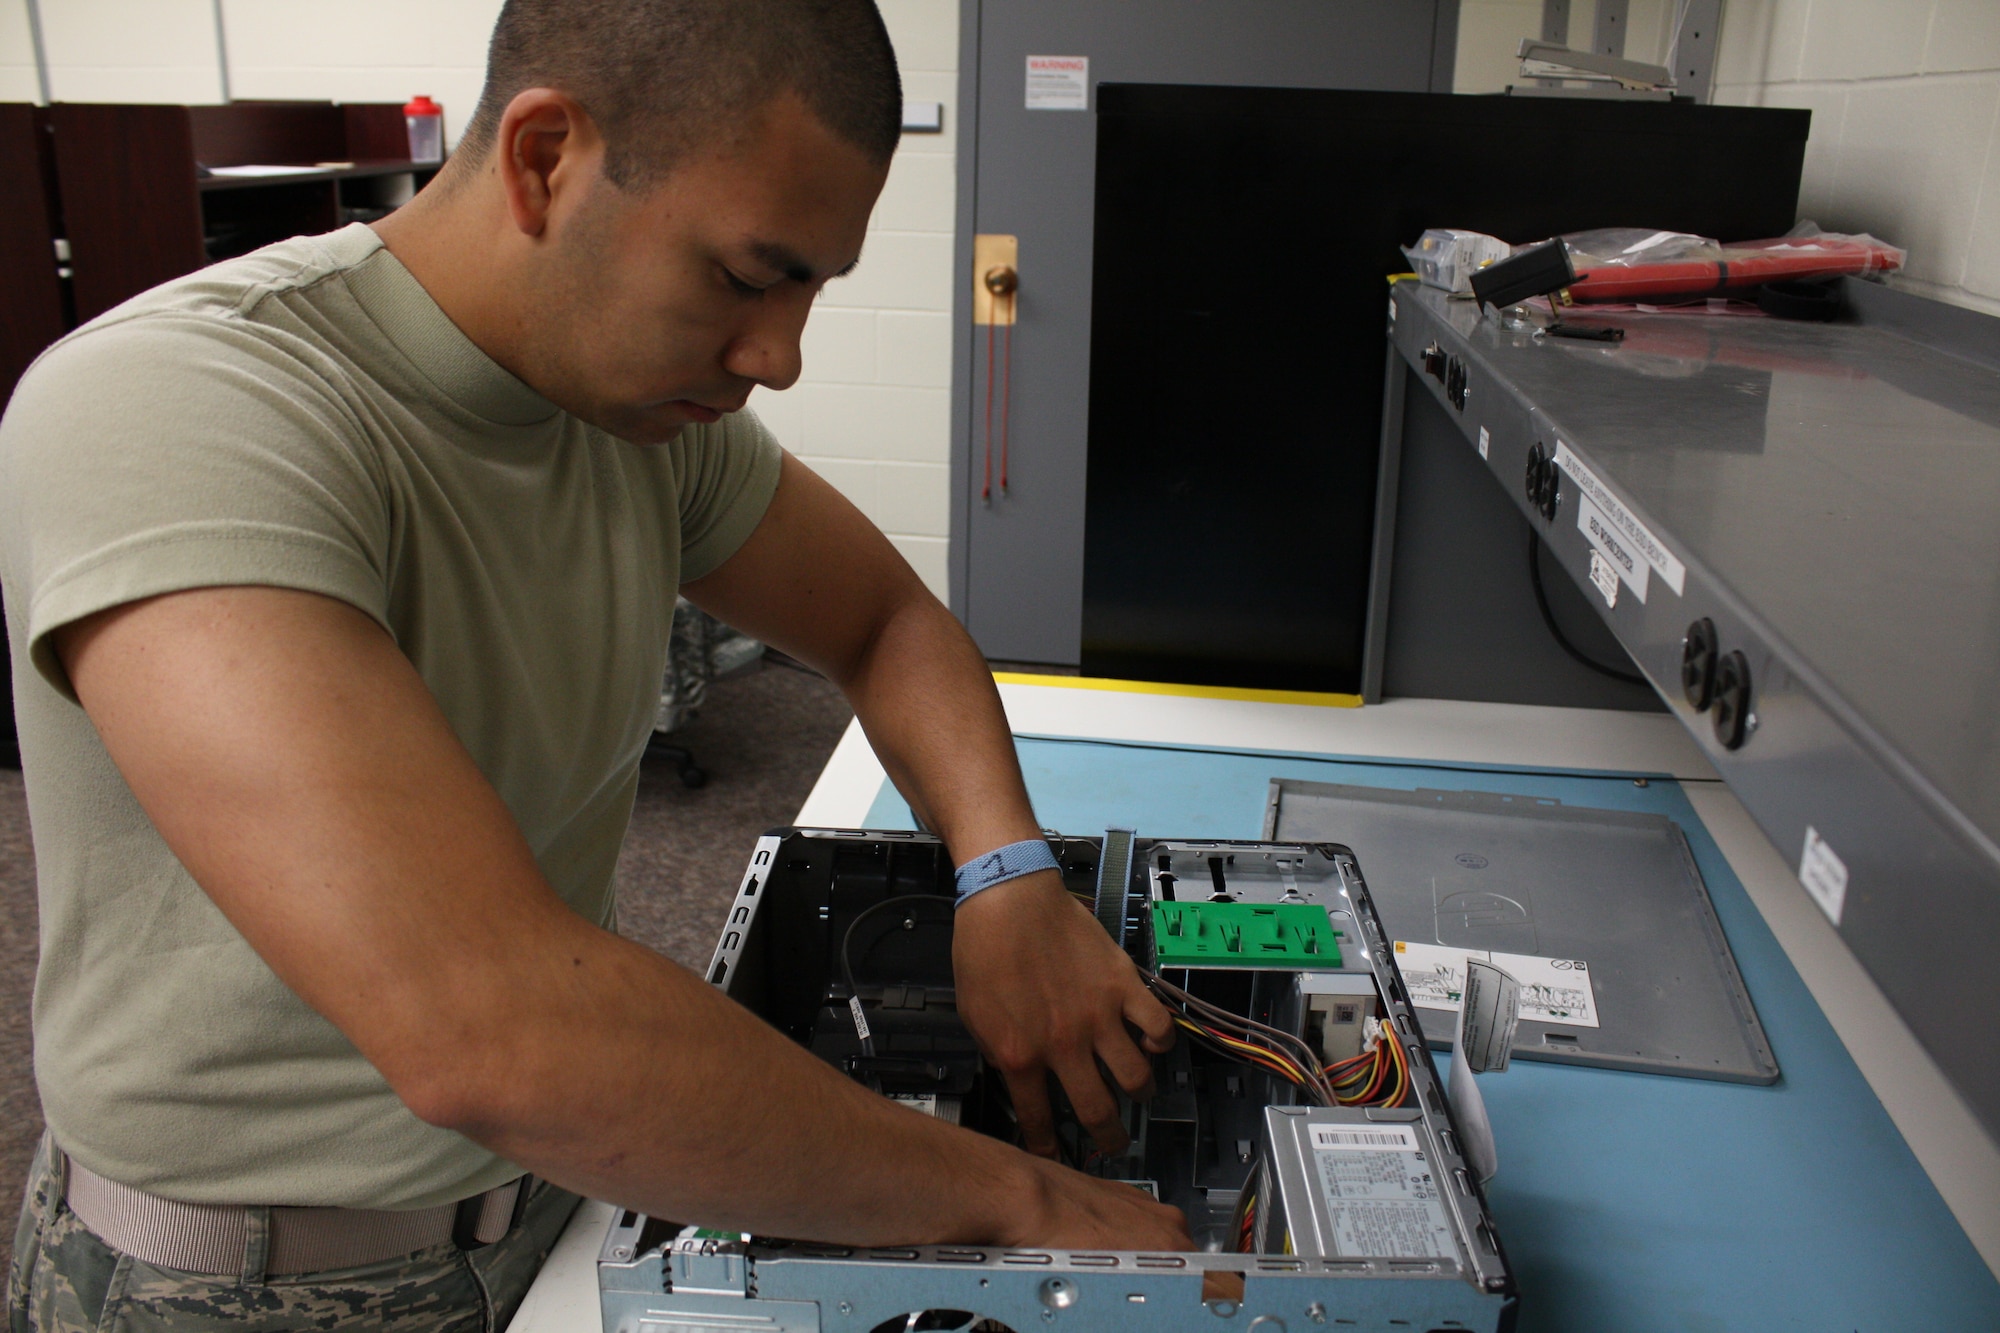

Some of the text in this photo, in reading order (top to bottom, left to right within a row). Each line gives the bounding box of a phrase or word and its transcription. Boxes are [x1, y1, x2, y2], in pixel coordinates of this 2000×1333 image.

[1030, 60, 1085, 71] WARNING
[1572, 461, 1581, 480] NOT
[1580, 470, 1595, 494] LEAVE
[1625, 515, 1636, 538] THE
[1647, 539, 1668, 573] BENCH
[1590, 516, 1600, 536] ESD
[1600, 526, 1633, 574] WORKCENTER
